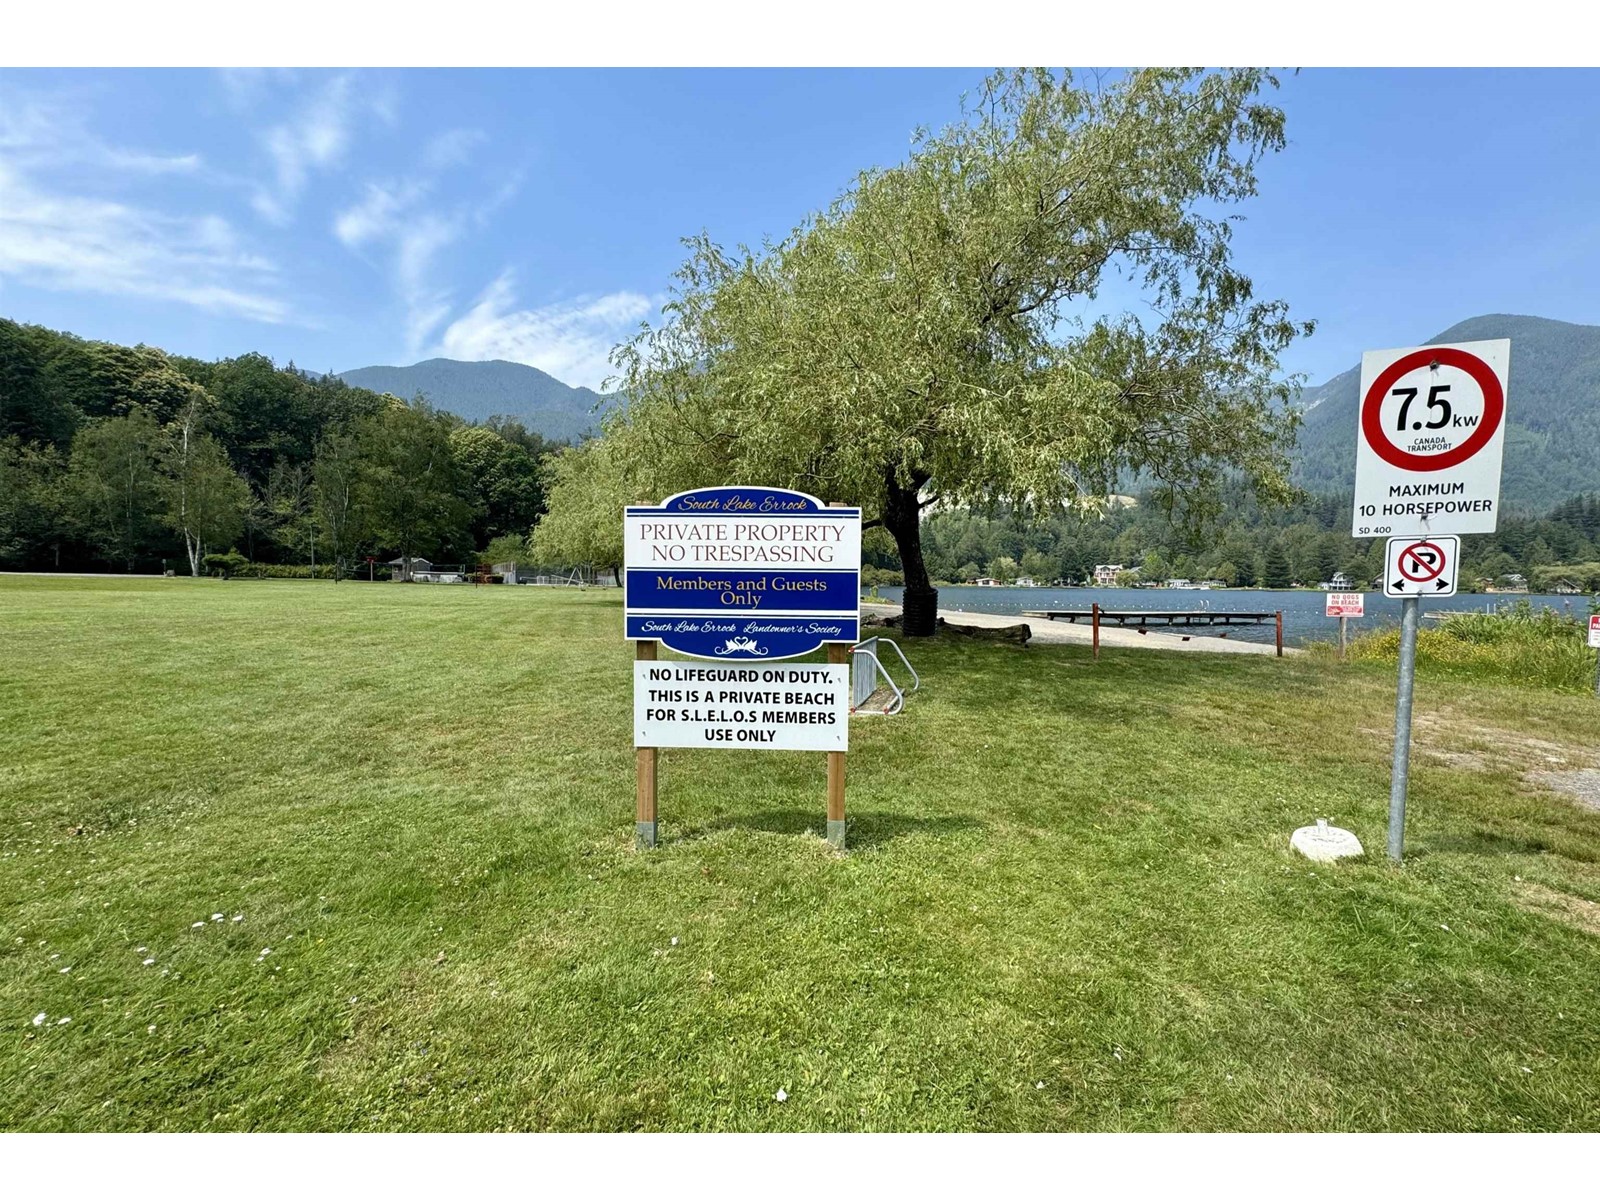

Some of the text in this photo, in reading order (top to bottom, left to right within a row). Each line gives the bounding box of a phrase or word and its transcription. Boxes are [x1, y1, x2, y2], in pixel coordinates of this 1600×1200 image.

[1392, 384, 1452, 431] 7.5
[1407, 442, 1452, 452] TRANSPORT
[1414, 437, 1446, 445] CANADA
[1389, 483, 1464, 497] MAXIMUM
[678, 495, 807, 511] South Lake Errock
[1359, 500, 1492, 517] 10 HORSEPOWER
[640, 524, 845, 541] PRIVATE PROPERTY
[652, 545, 833, 562] NO TRESPASSING
[657, 576, 827, 591] Members and Guests
[721, 591, 762, 609] Only
[642, 621, 672, 632] South
[674, 621, 699, 632] Lake
[701, 622, 736, 632] Errock
[805, 624, 841, 635] Society
[650, 669, 833, 684] NO LIFEGUARD ON DUTY.
[649, 690, 834, 705] THIS IS A PRIVATE BEACH
[647, 709, 836, 724] FOR S.L.E.L.O.S MEMBERS
[705, 729, 776, 742] USE ONLY
